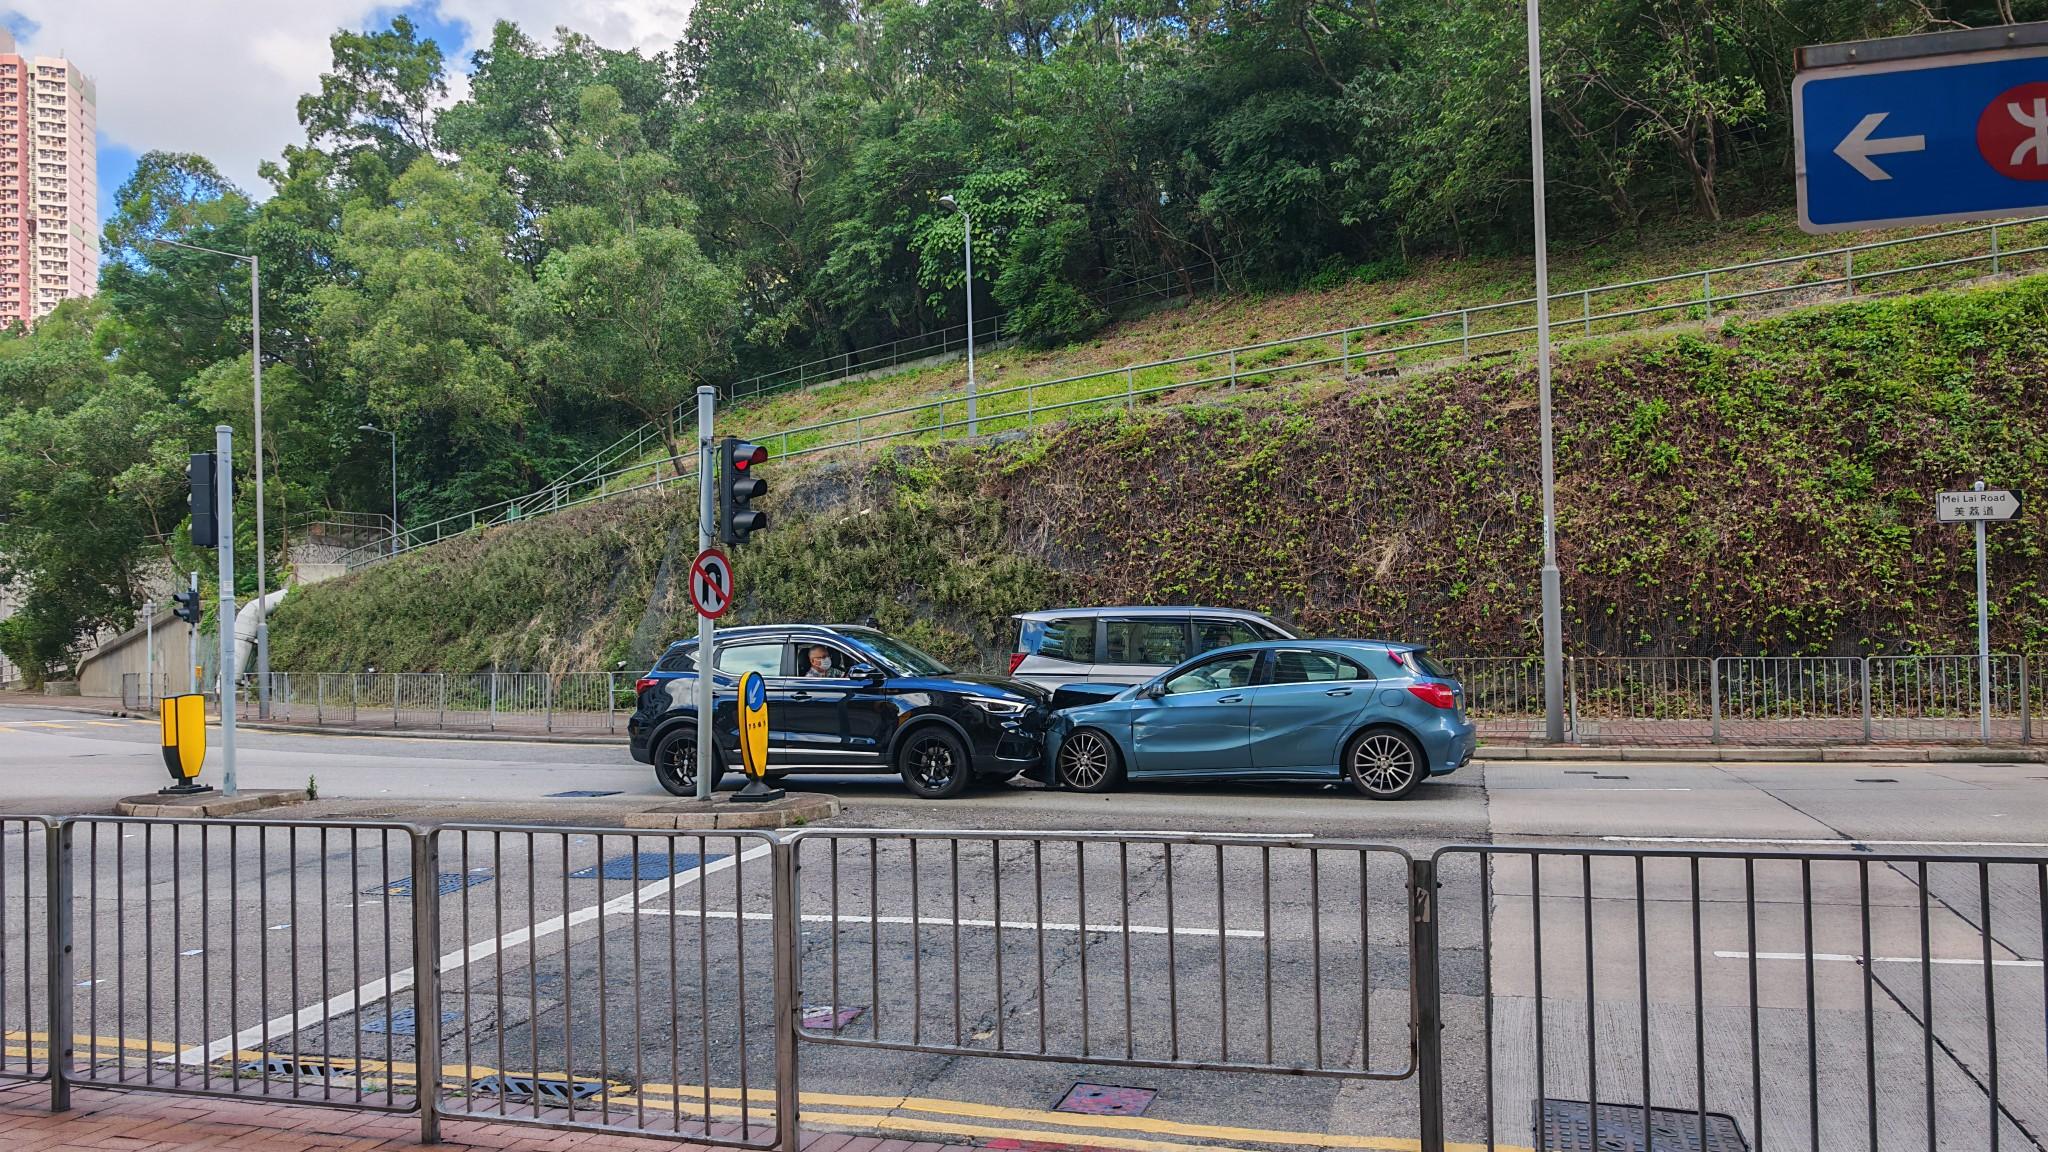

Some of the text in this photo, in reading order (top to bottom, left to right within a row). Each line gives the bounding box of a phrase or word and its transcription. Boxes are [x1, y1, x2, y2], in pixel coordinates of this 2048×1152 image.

[1942, 494, 2006, 503] Mei Lai Road
